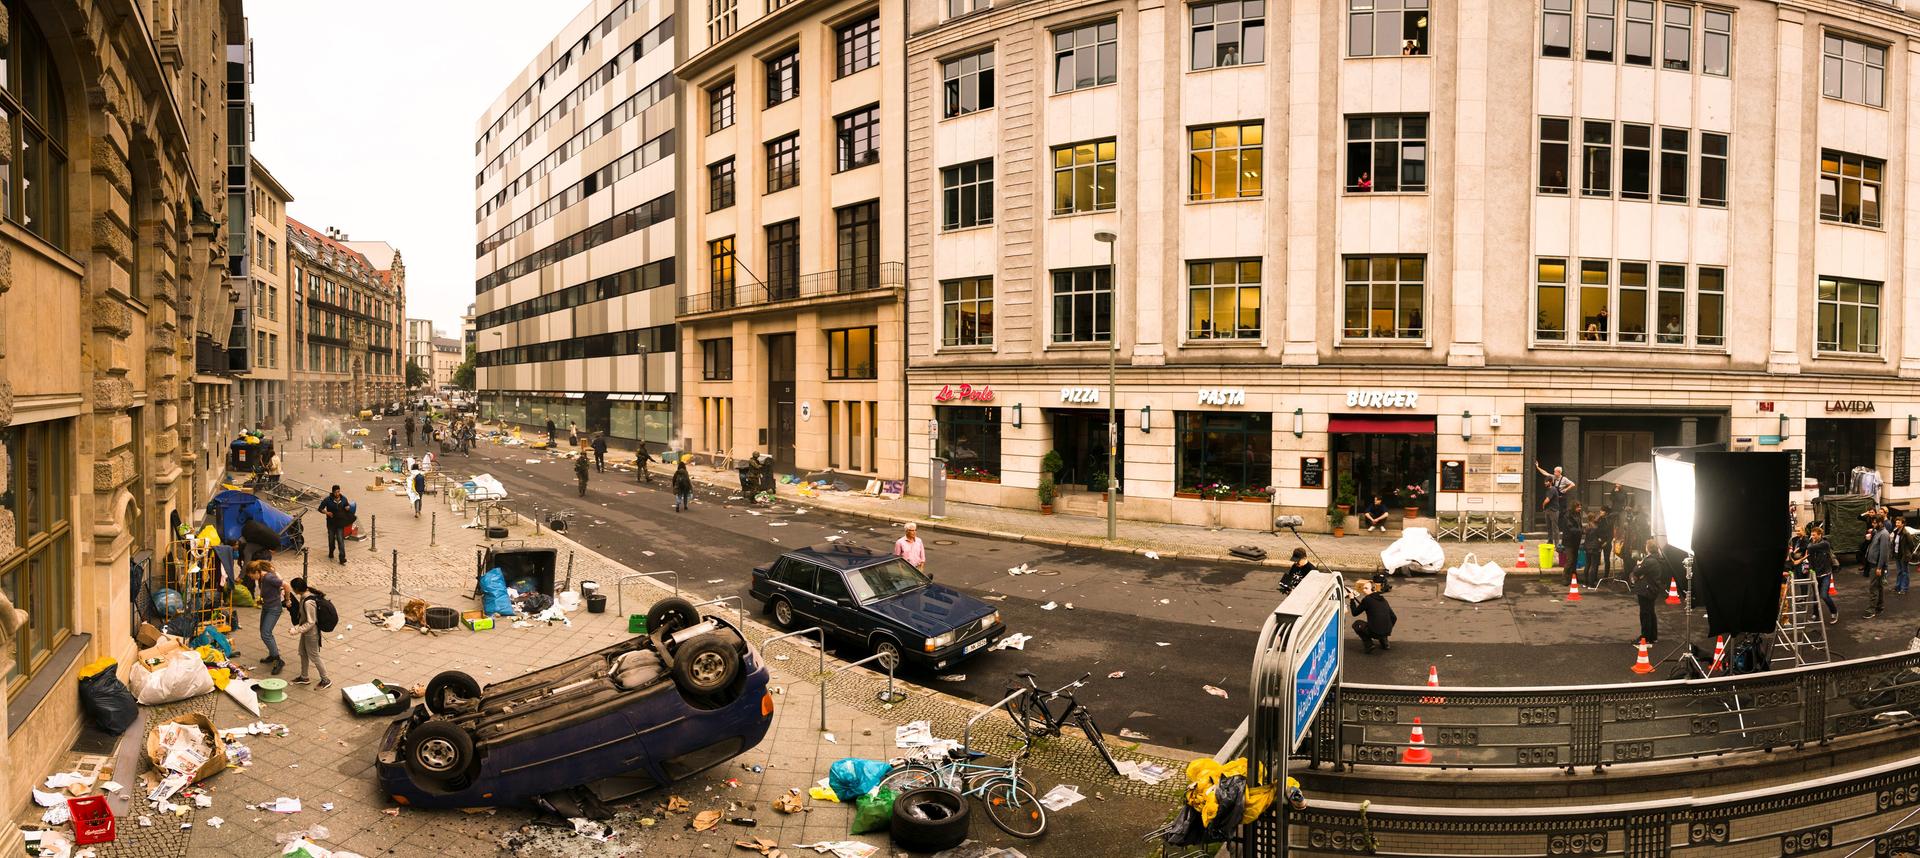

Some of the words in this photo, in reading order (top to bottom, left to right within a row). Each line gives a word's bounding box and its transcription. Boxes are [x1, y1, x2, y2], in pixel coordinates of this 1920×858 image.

[935, 384, 954, 402] La
[958, 383, 995, 402] Perle
[1060, 388, 1099, 403] PIZZA
[1198, 389, 1245, 405] PASTA
[1346, 390, 1419, 408] BURGER
[1825, 400, 1875, 413] LAVIDA
